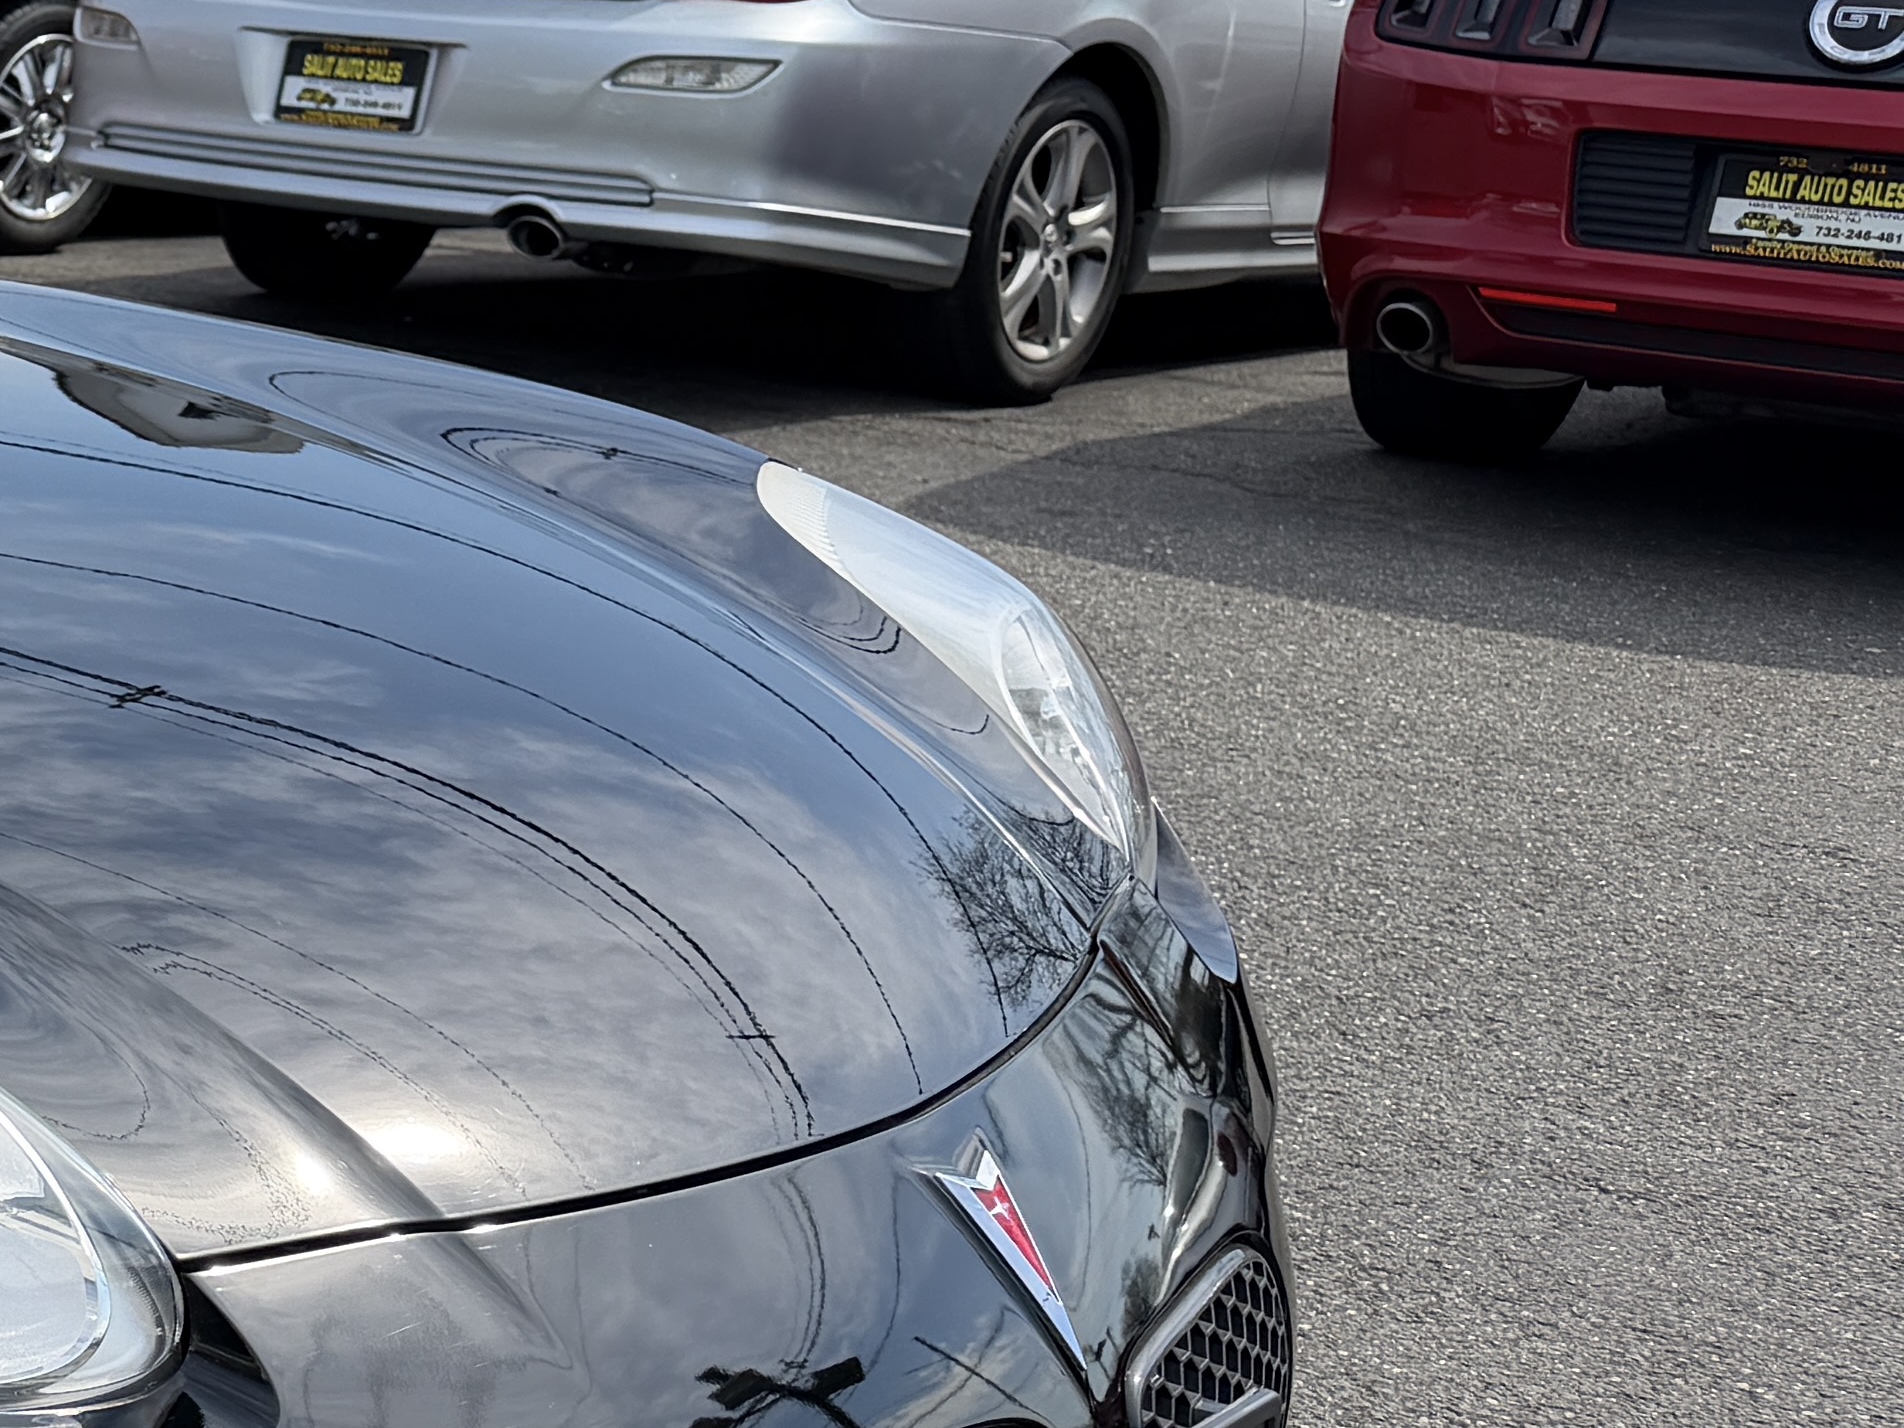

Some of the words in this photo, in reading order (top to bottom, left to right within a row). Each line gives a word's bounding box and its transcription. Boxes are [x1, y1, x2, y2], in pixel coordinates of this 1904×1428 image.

[1833, 5, 1904, 31] GT
[1745, 170, 1799, 198] SALIT
[1796, 174, 1849, 204] AUTO
[1849, 178, 1904, 210] SALES
[1816, 225, 1904, 245] 732-246-481
